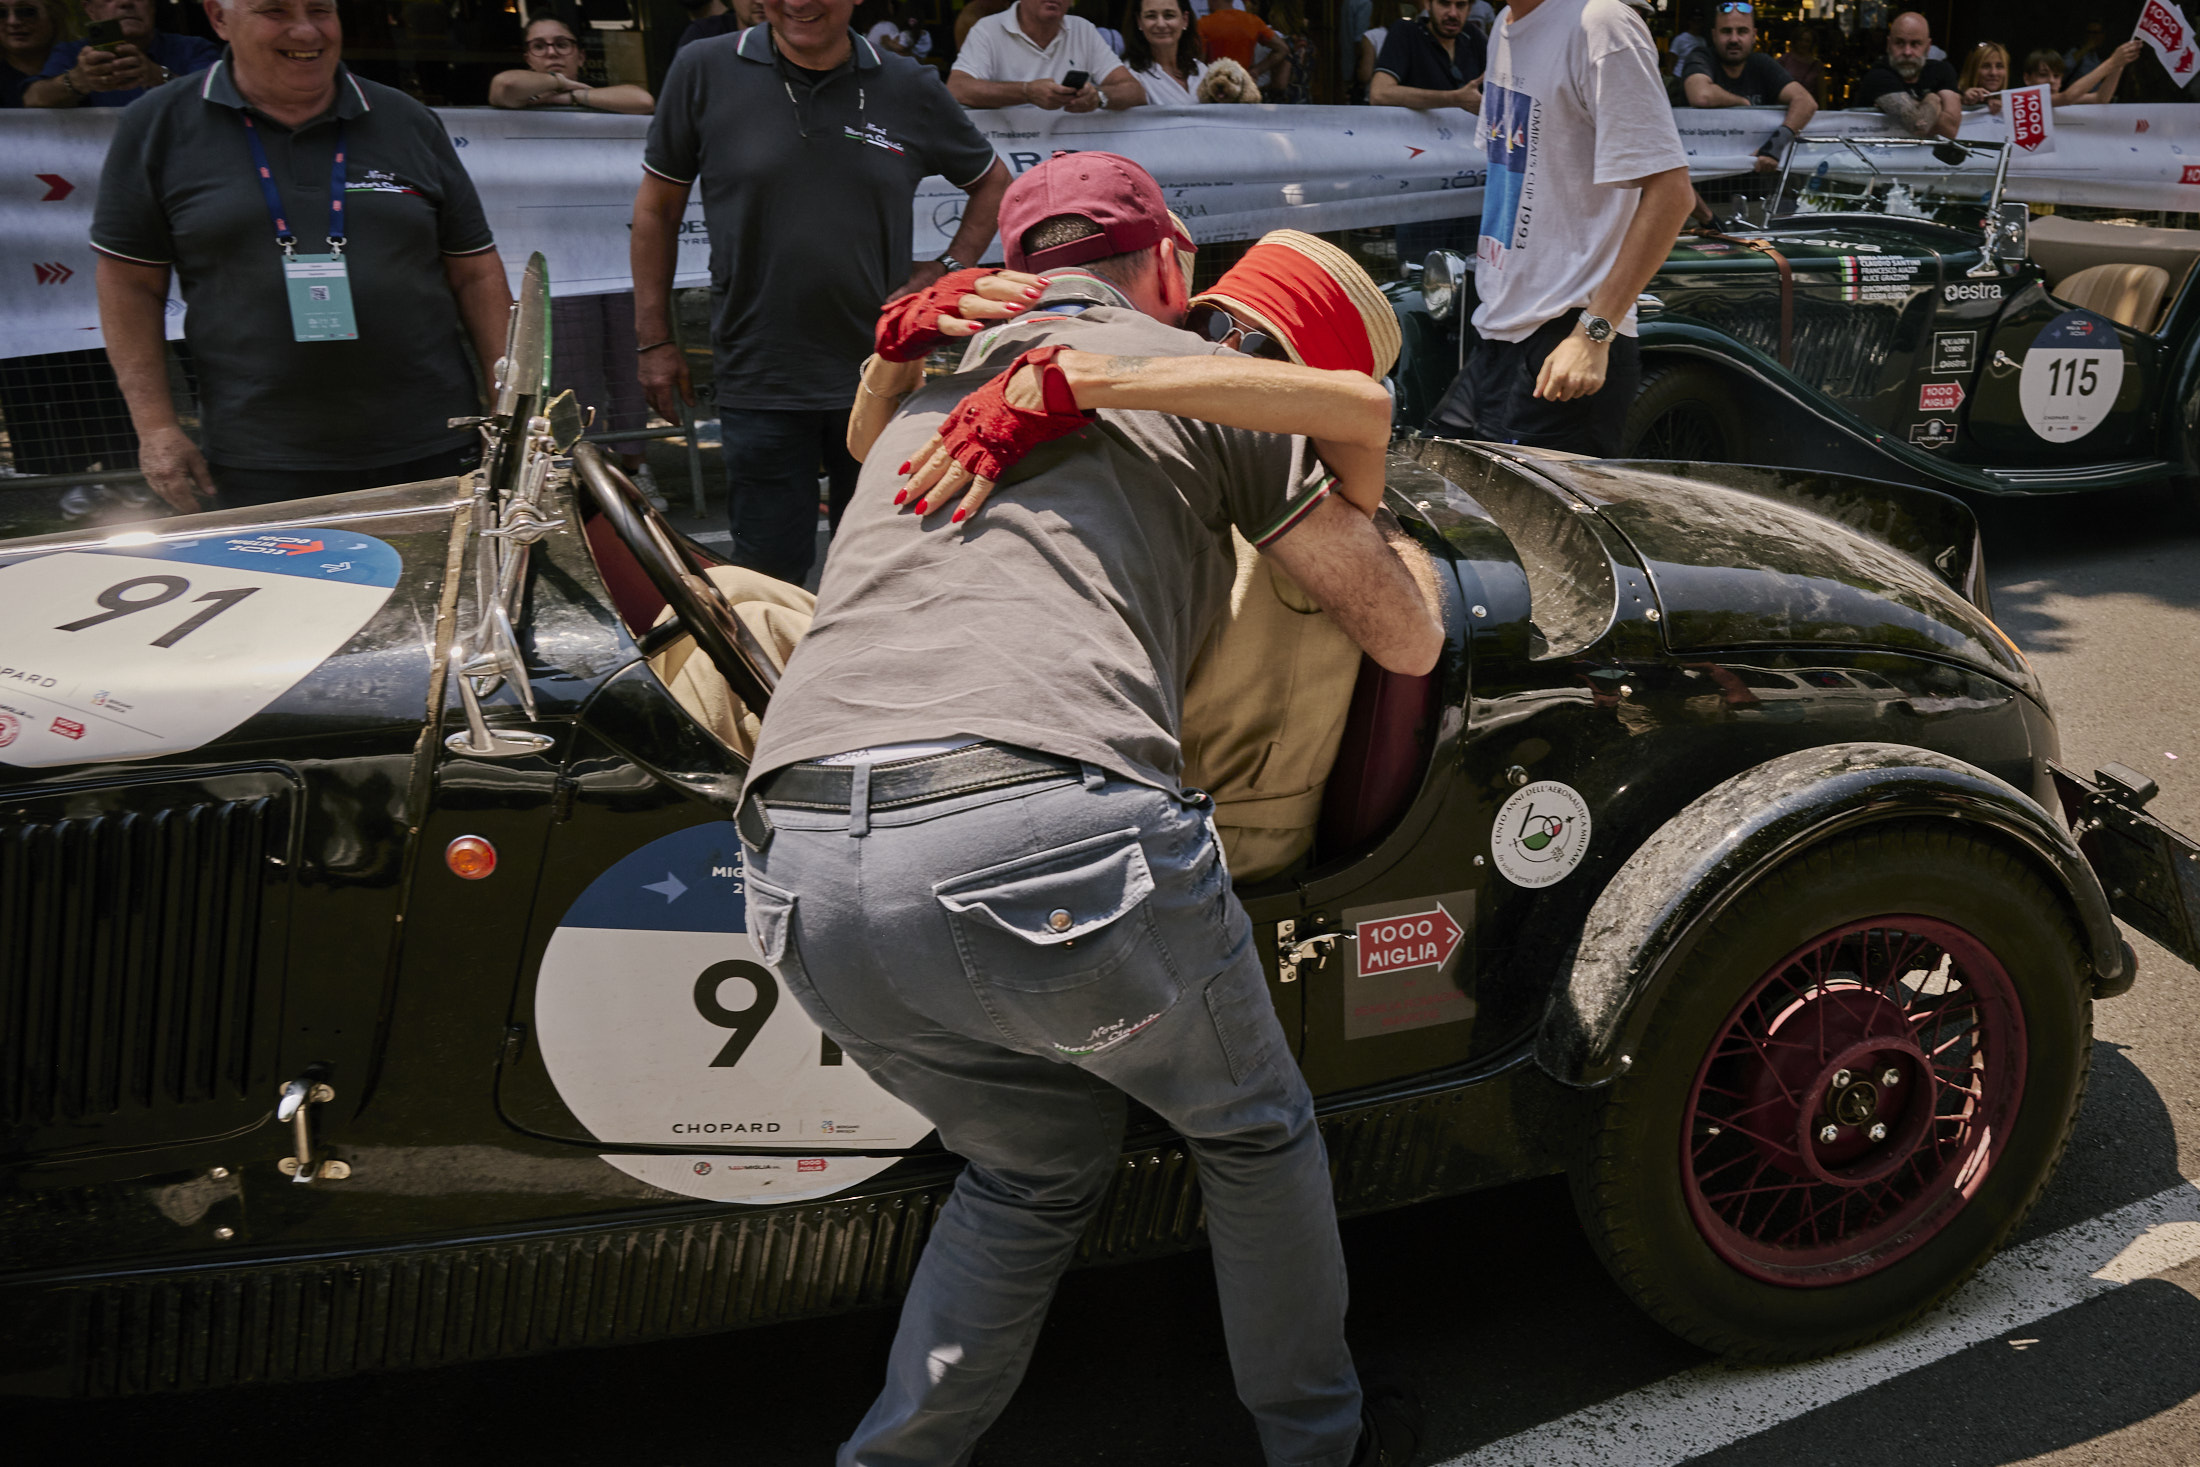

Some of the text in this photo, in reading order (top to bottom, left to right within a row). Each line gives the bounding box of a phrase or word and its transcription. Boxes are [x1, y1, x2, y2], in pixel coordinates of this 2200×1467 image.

[2149, 5, 2179, 34] 1000
[2013, 94, 2029, 140] MIGLIA
[2027, 94, 2042, 135] 1000
[990, 130, 1041, 140] Timekeeper
[1529, 98, 1543, 168] ADMIRAL'S
[1678, 128, 1745, 138] fficial Sparkling Wine
[1523, 170, 1537, 200] CUP
[1515, 204, 1533, 250] 1993
[1860, 267, 1898, 275] FRANCESCO
[1891, 259, 1922, 267] SANTINI
[1861, 274, 1881, 282] ALICE
[1958, 282, 2002, 300] estra
[2048, 358, 2100, 396] 115
[1922, 397, 1954, 407] MIGLIA
[1926, 387, 1954, 396] 1000
[52, 574, 263, 649] 91
[0, 665, 58, 689] PARD
[1494, 813, 1508, 845] CENTO
[1506, 793, 1525, 813] ANNI
[1567, 829, 1588, 867] MILITARE
[1370, 919, 1433, 945] 1000
[1366, 941, 1438, 969] MIGLIA
[671, 1122, 781, 1134] CHOPARD
